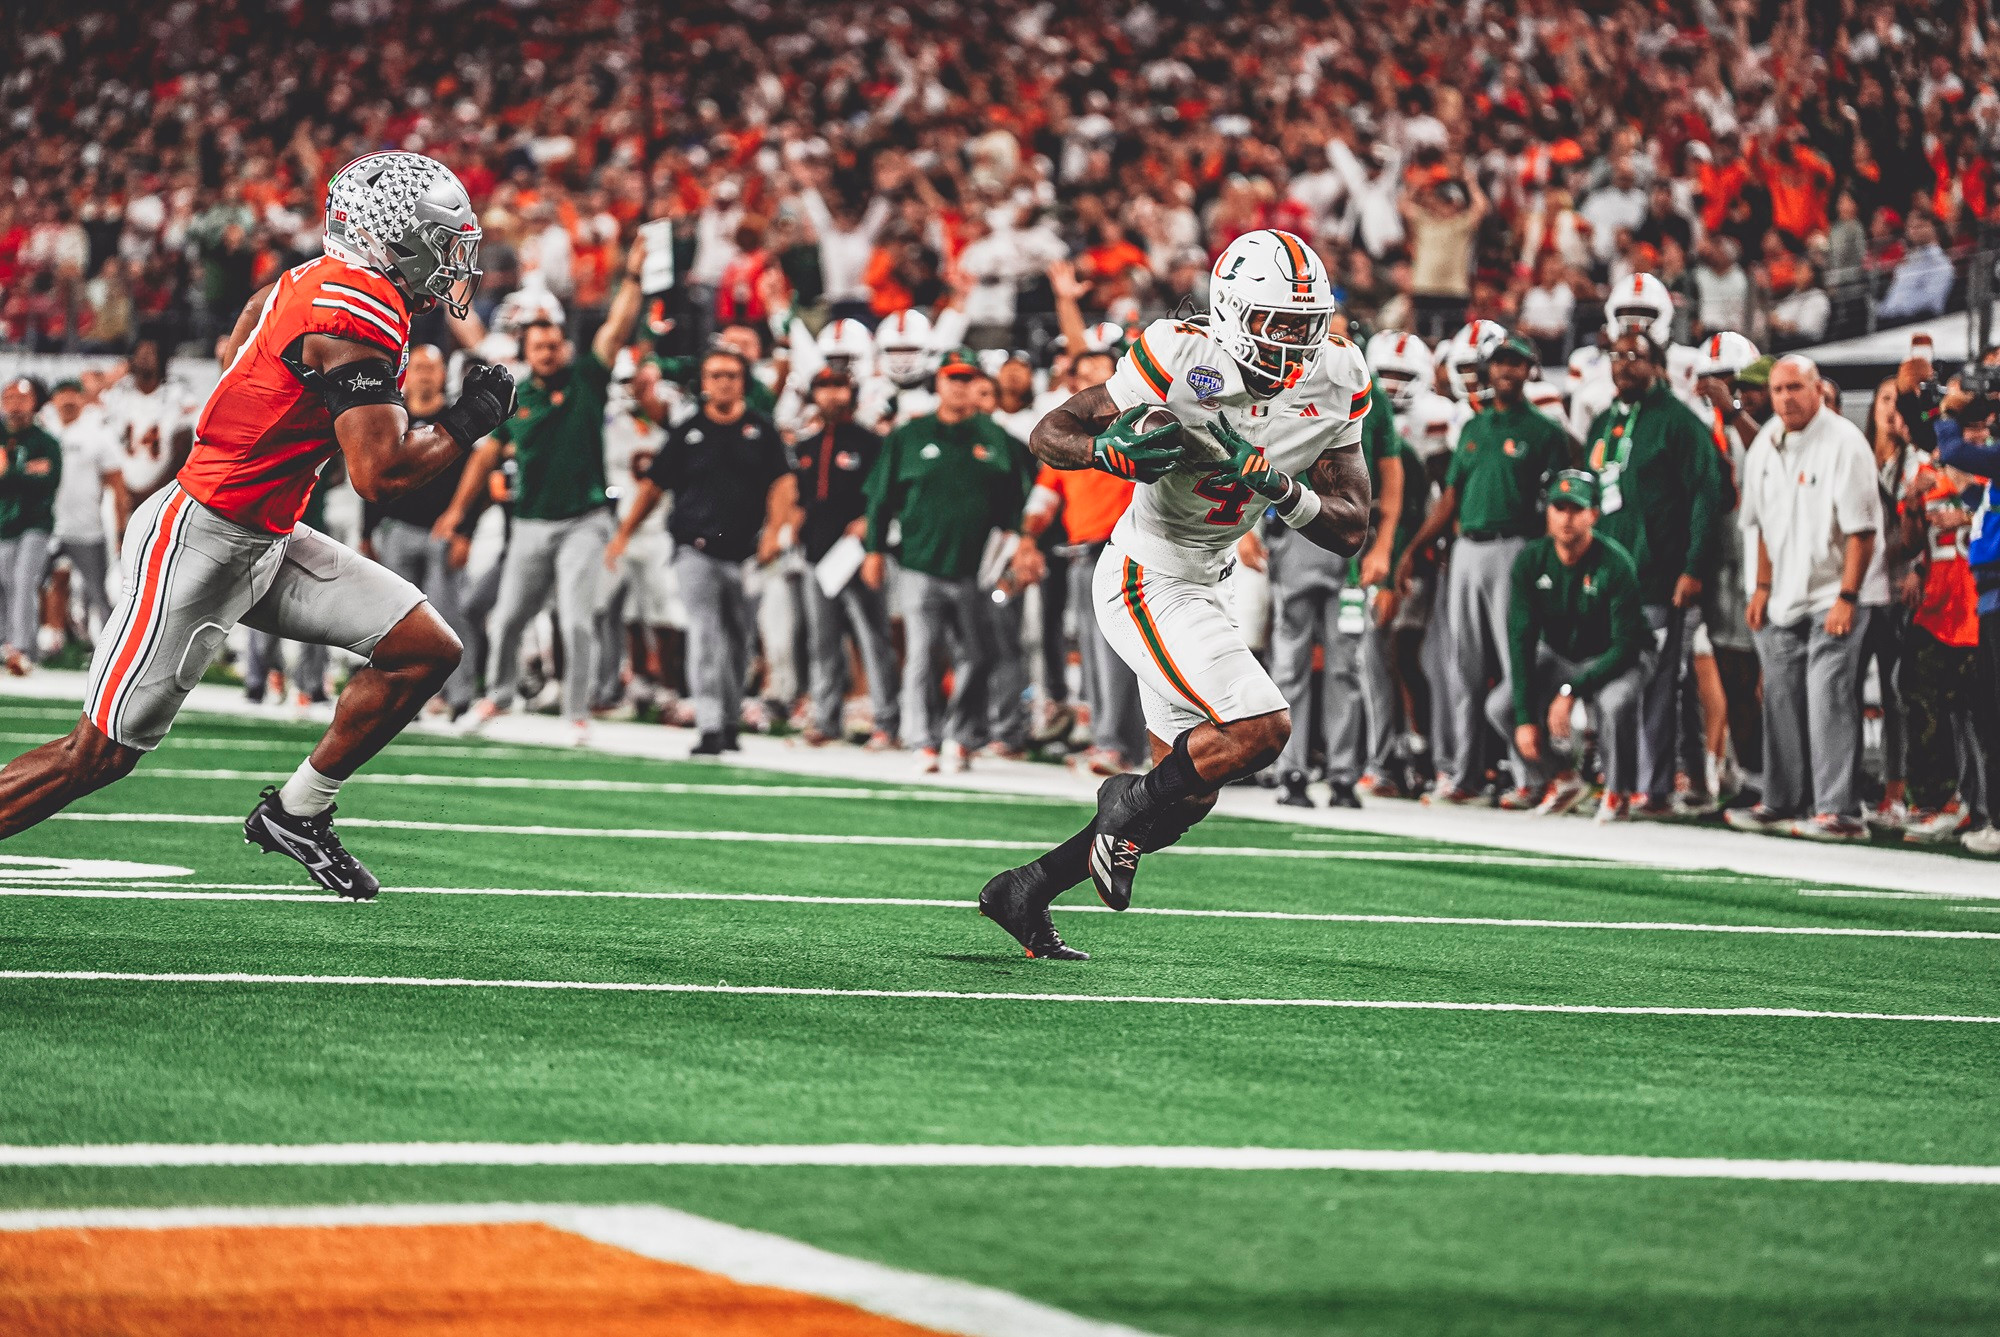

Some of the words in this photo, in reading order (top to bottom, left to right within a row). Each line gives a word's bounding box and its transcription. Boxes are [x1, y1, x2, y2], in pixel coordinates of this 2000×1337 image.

[1292, 295, 1315, 303] MIAMI
[357, 378, 383, 387] Douglas
[1189, 372, 1223, 389] COTTON
[1191, 446, 1266, 525] 4
